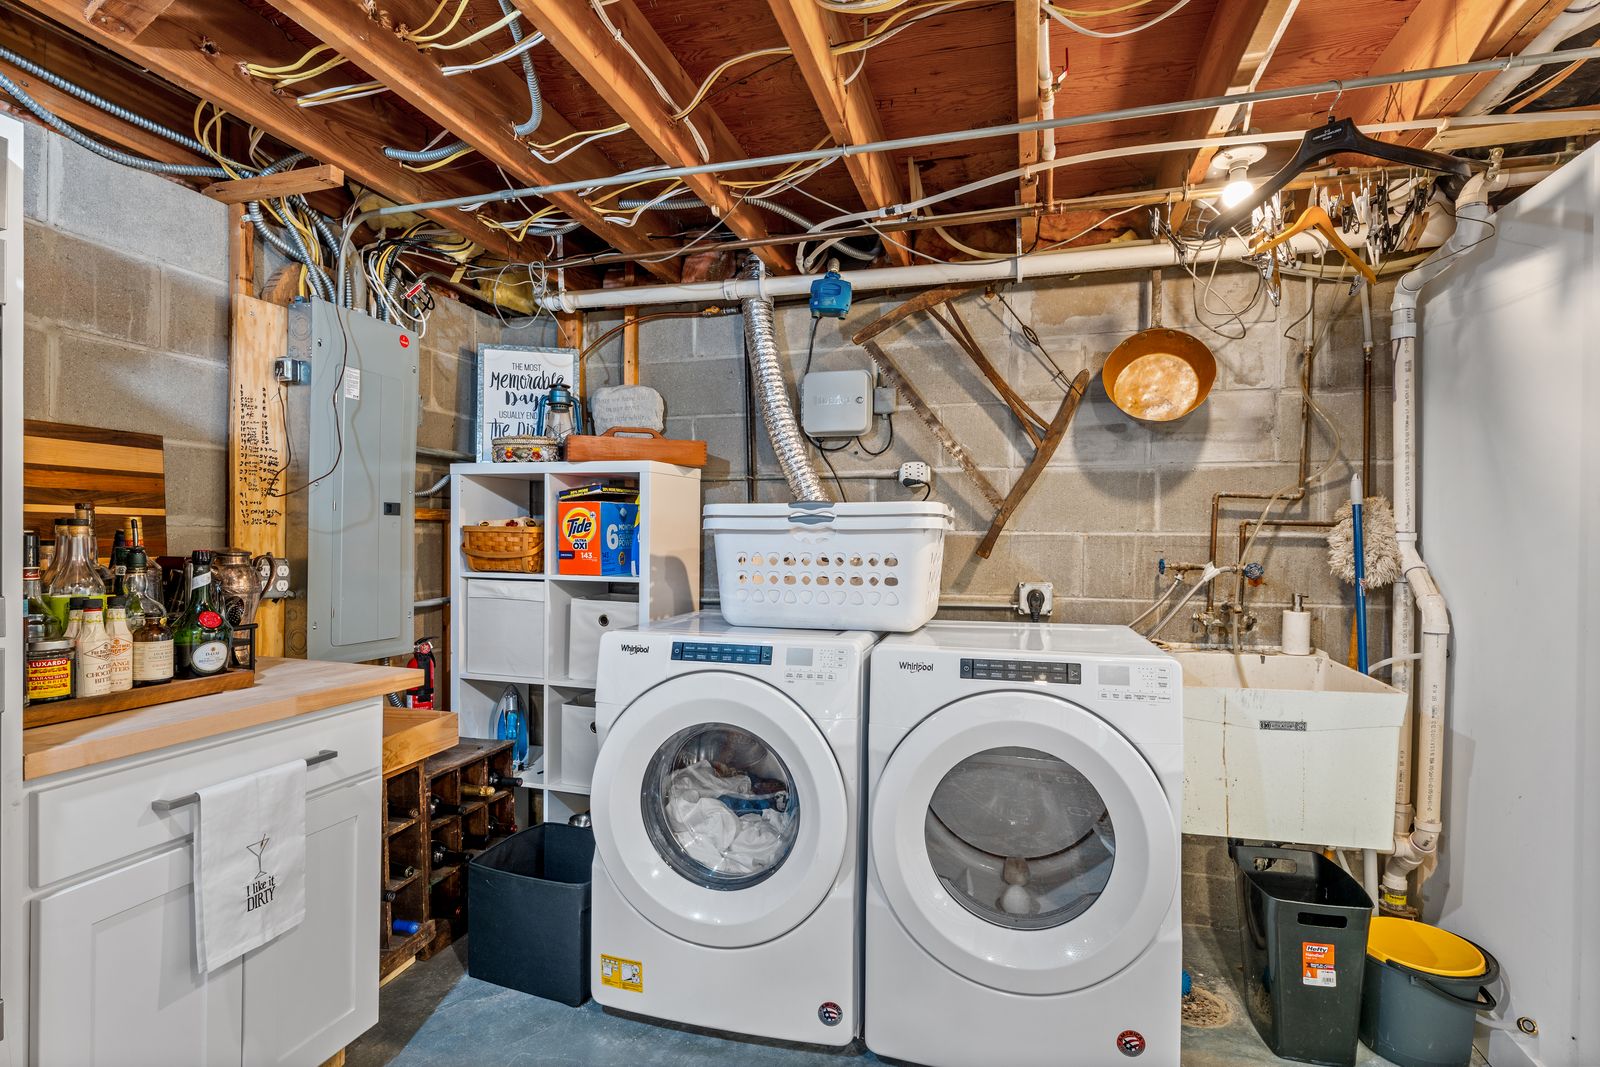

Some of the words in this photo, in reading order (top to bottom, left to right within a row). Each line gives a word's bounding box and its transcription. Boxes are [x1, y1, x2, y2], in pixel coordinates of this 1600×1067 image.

[512, 363, 523, 371] THE
[489, 371, 564, 391] Memorable
[499, 410, 525, 420] USUALLY
[567, 518, 592, 537] Tide
[607, 524, 619, 550] 6
[572, 542, 588, 550] OXI
[620, 644, 649, 655] Whirlpool
[32, 660, 67, 668] LUXARDO
[899, 661, 934, 673] Whirlpool
[246, 885, 250, 897] I
[252, 880, 267, 894] like
[268, 875, 275, 887] it
[247, 885, 276, 912] DIRTY
[1306, 945, 1328, 953] Hefty
